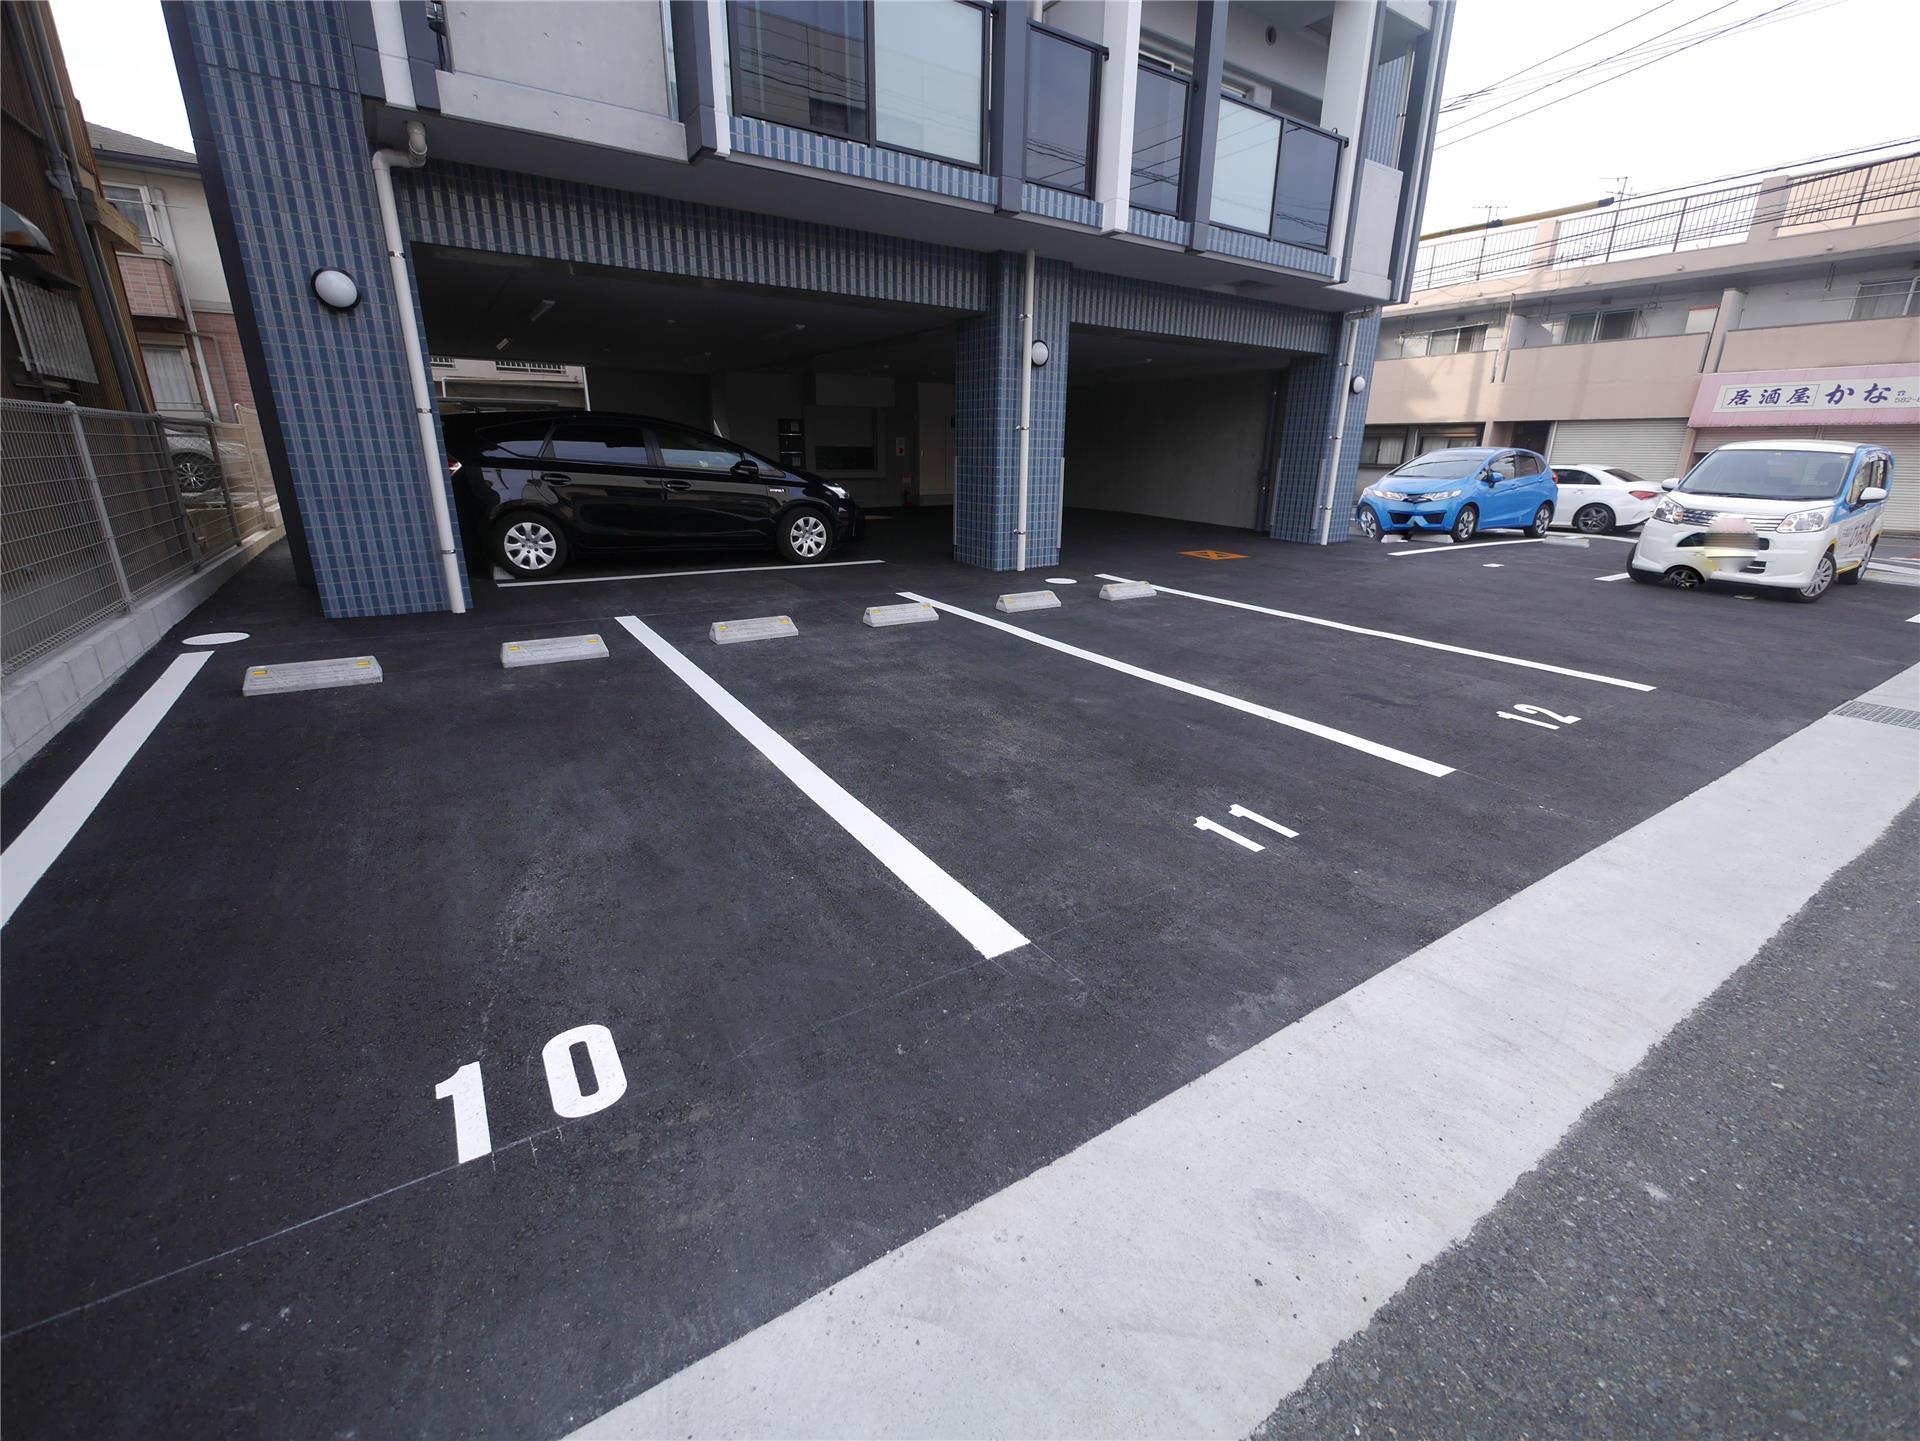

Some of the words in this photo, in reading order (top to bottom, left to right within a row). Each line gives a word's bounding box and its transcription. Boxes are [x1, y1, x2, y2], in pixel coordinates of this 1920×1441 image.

[1727, 387, 1812, 406] 居酒屋
[1824, 383, 1892, 405] かな
[1496, 703, 1582, 730] 12
[1193, 803, 1300, 853] 11
[435, 1024, 628, 1164] 10
